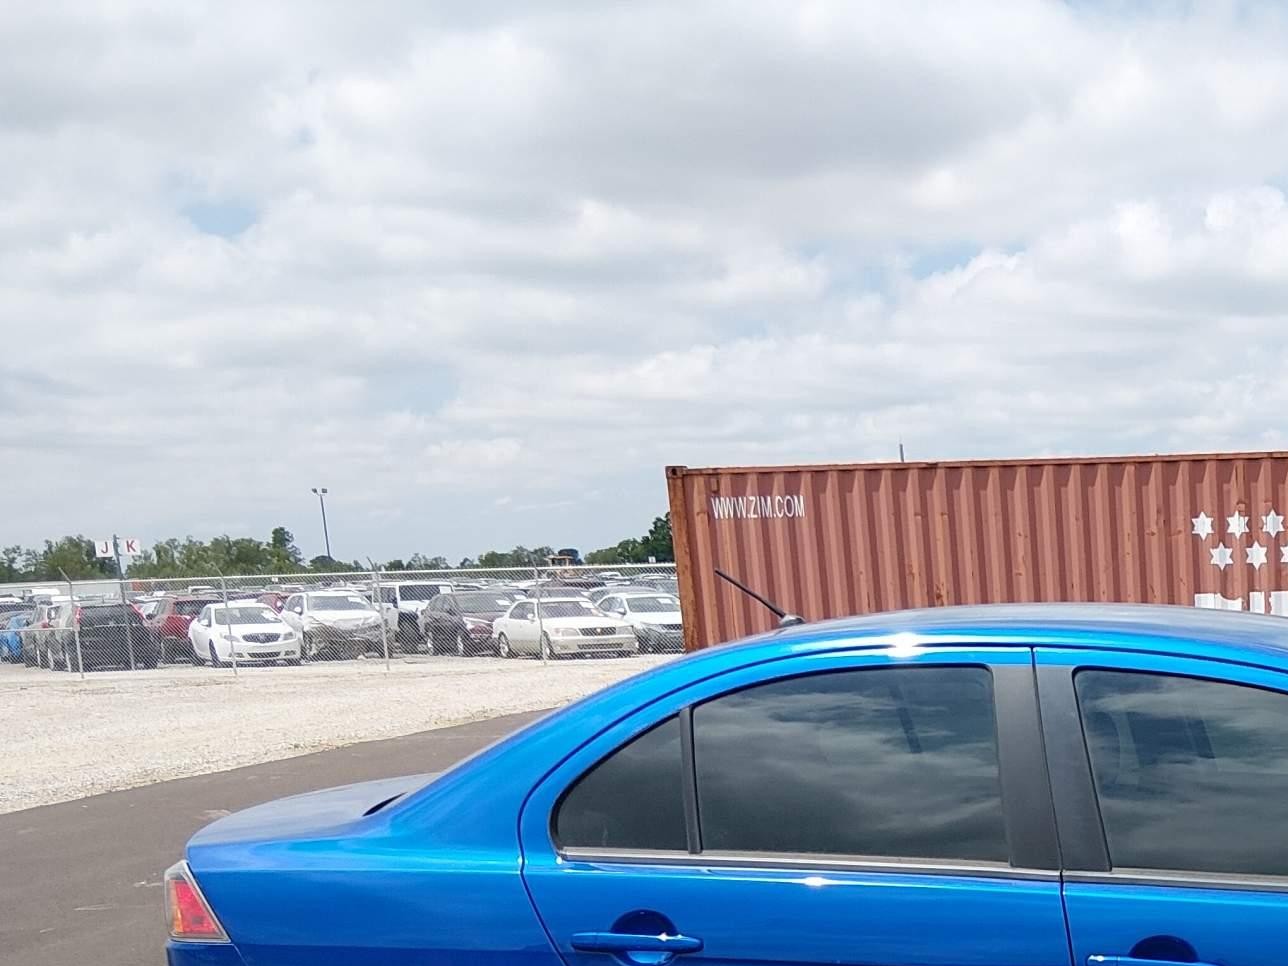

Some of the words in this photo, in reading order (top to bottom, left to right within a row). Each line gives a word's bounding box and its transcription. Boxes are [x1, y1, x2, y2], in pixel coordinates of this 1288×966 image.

[711, 495, 805, 519] WWW.ZIM.COM
[101, 541, 108, 553] J
[126, 540, 136, 552] K
